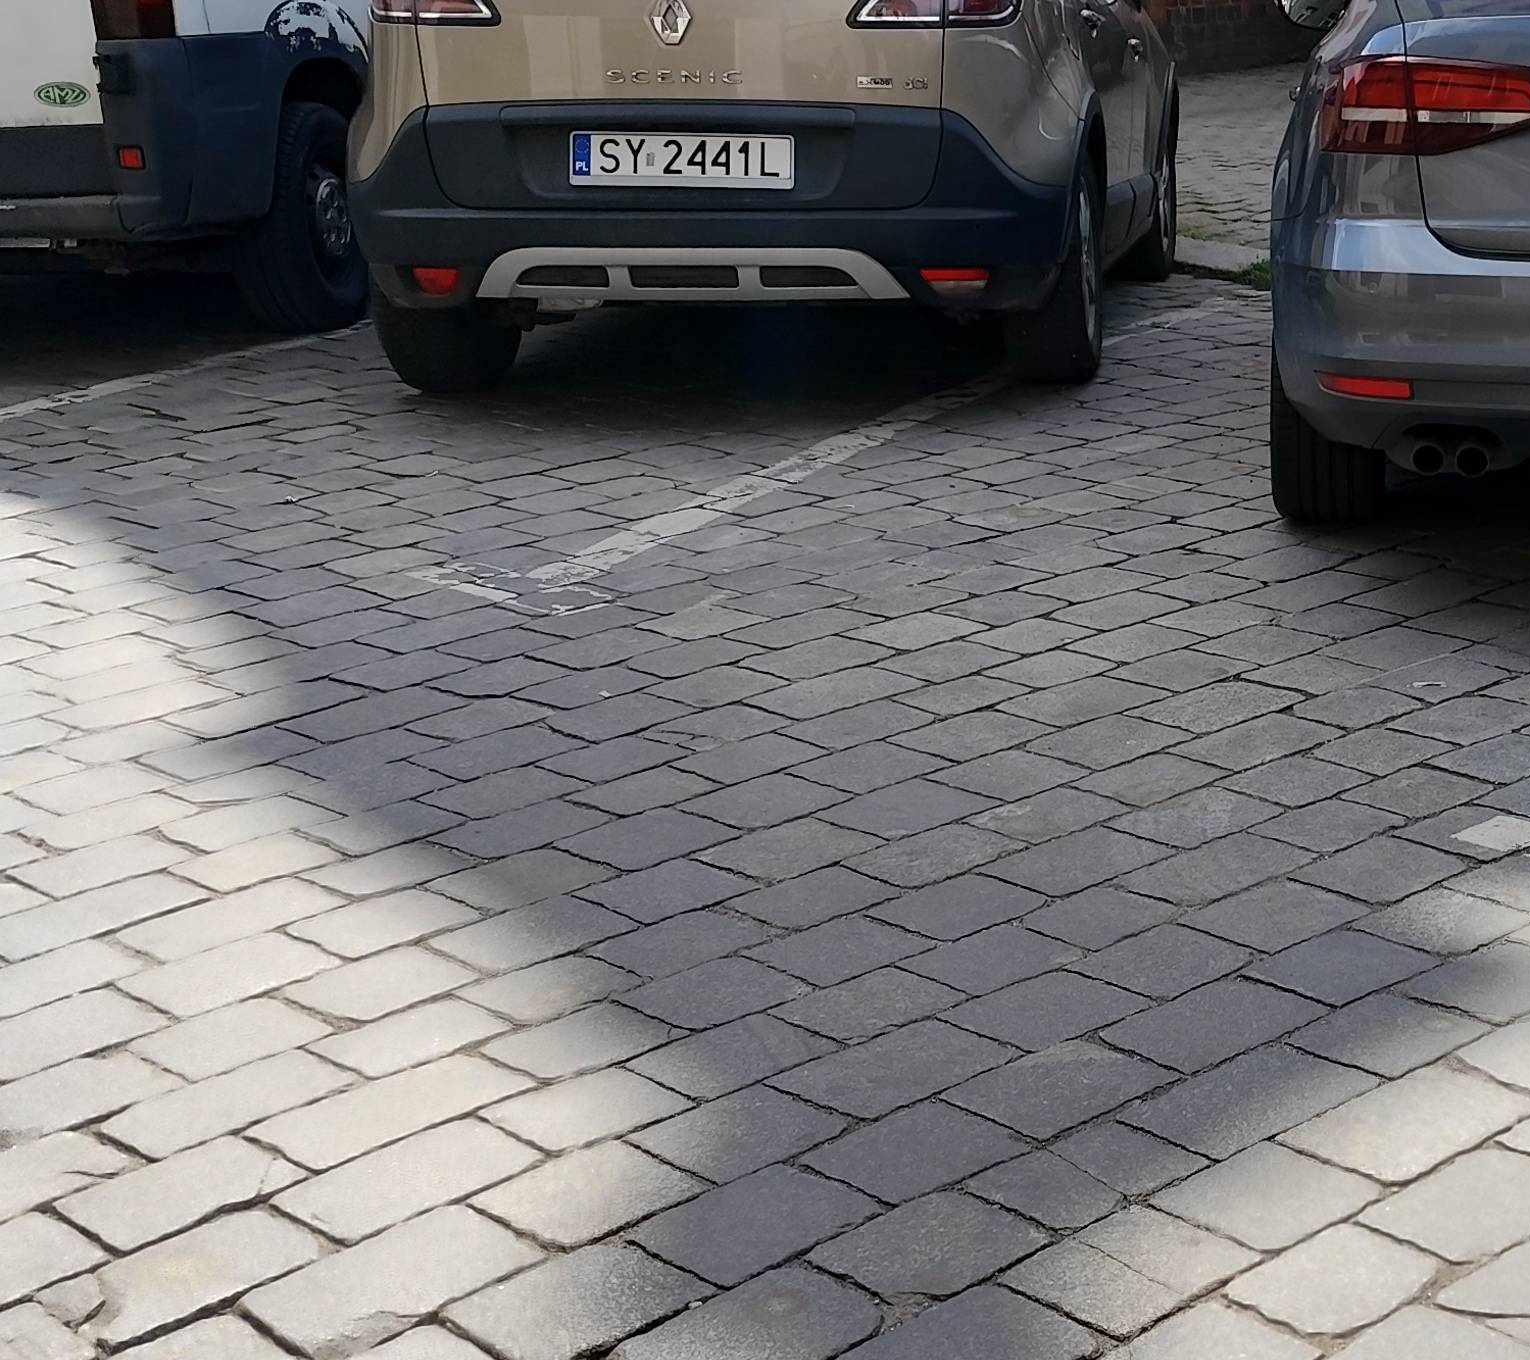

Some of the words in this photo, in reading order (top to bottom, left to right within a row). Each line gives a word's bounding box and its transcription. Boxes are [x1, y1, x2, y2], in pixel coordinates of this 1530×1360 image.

[605, 69, 743, 85] SCENIC
[575, 161, 589, 172] PL
[600, 138, 646, 174] SY
[663, 139, 780, 177] 2441L
